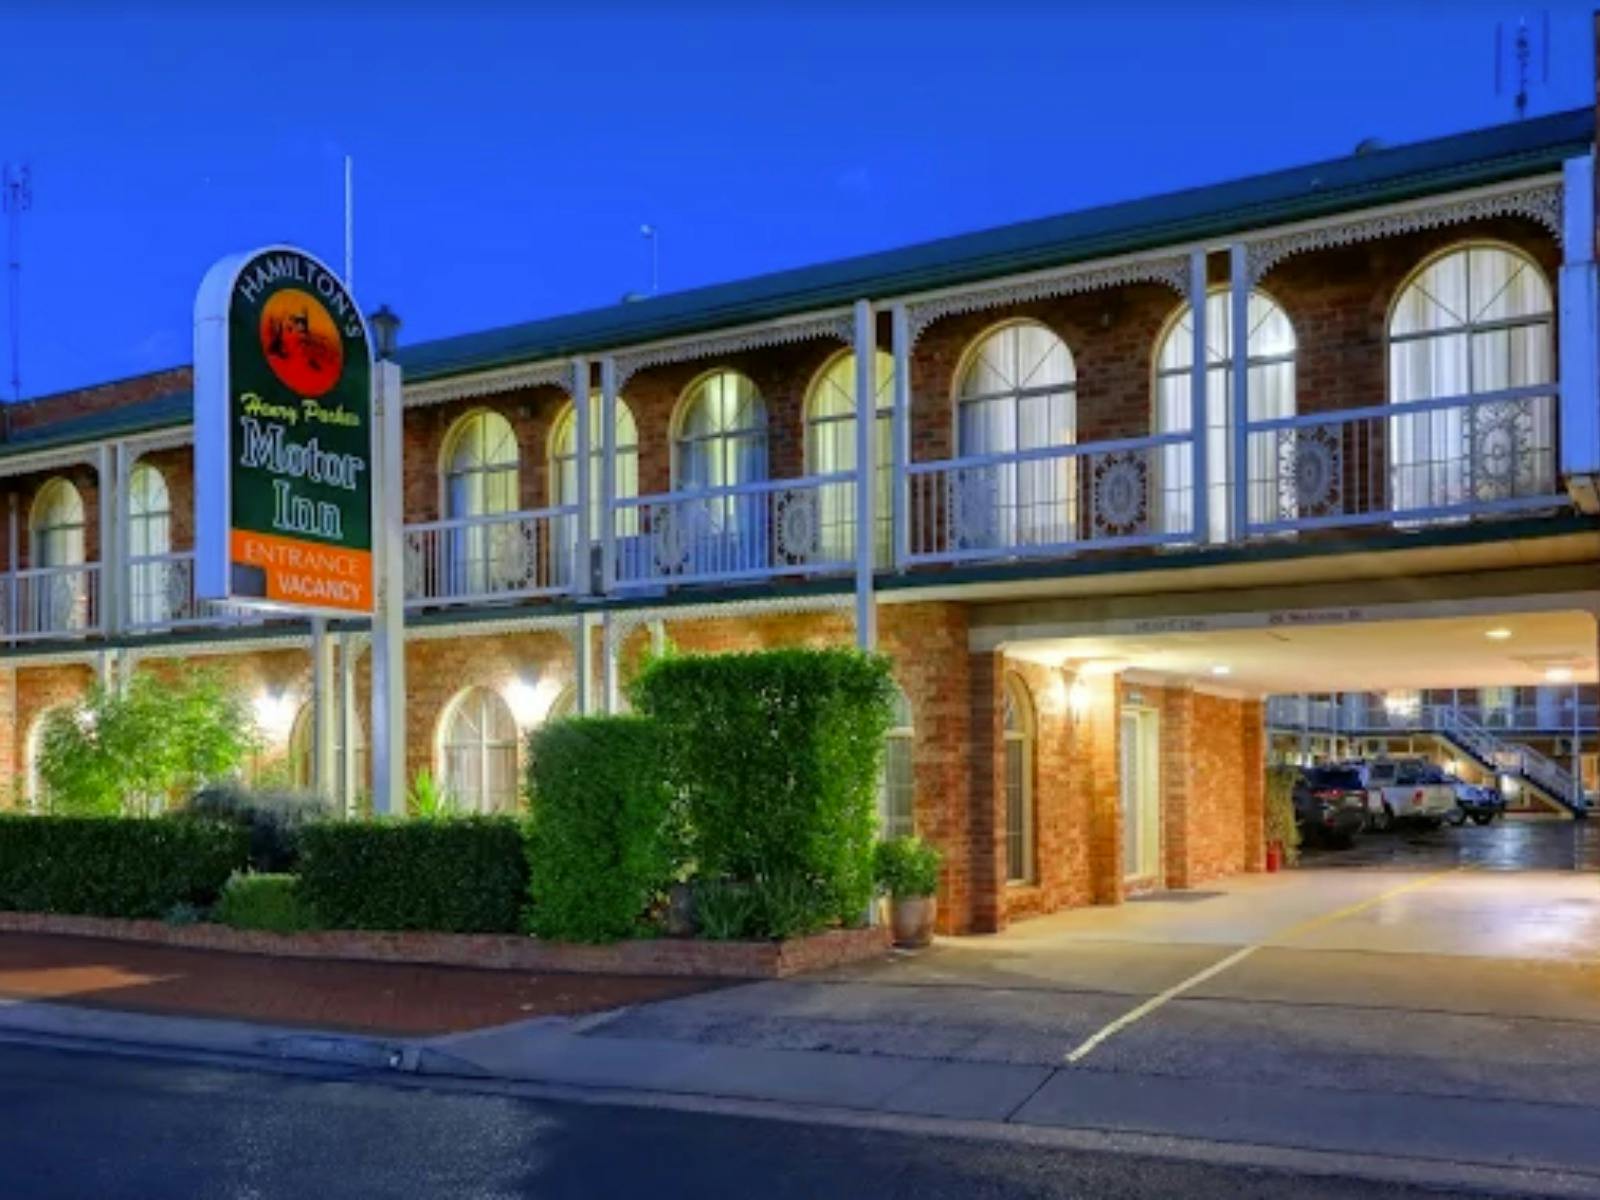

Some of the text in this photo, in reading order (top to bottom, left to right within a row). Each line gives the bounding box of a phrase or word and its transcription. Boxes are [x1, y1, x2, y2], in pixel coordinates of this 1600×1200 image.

[240, 255, 362, 338] HAMILTON'S
[240, 392, 298, 426] Henry
[240, 416, 366, 490] Motor
[272, 479, 343, 540] Inn
[246, 539, 360, 576] ENTRANCE
[277, 573, 363, 602] VACANCY
